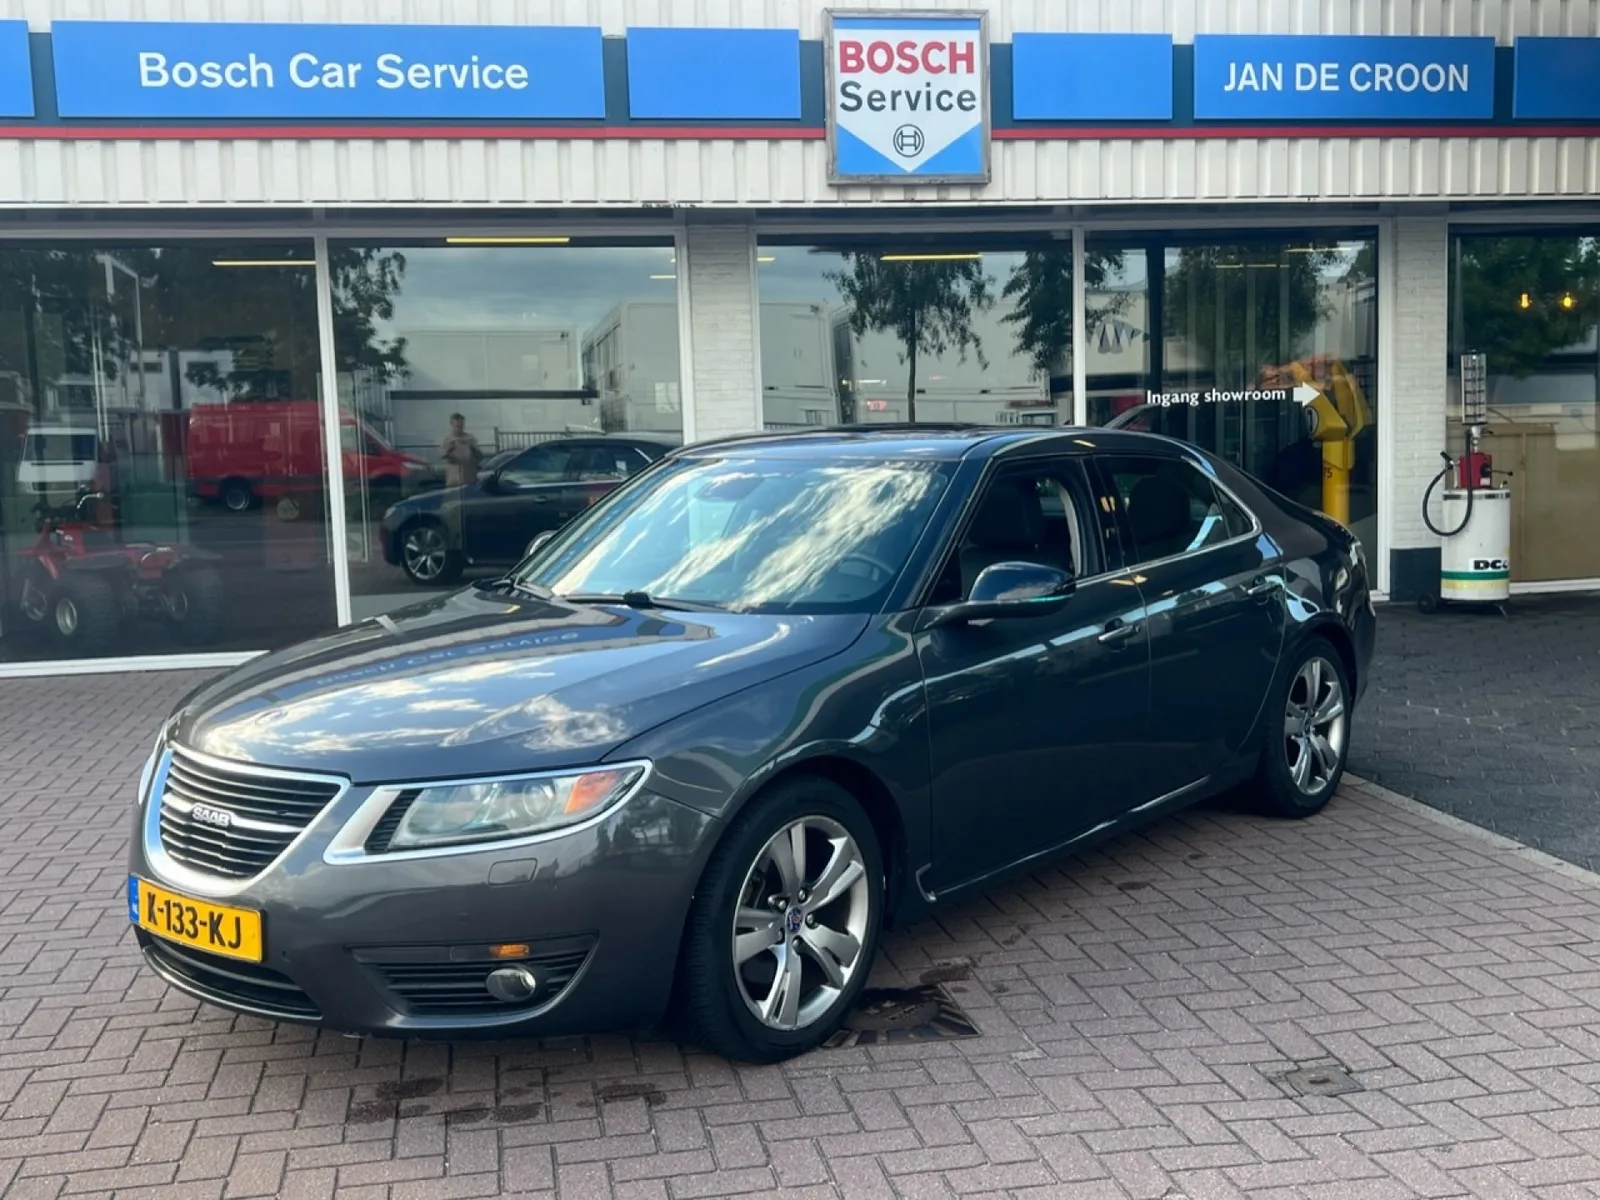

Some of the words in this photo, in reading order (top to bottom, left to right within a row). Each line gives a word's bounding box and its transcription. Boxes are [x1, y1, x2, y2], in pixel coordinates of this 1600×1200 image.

[139, 52, 274, 87] Bosch
[288, 52, 362, 88] Car
[376, 54, 529, 89] Service
[839, 40, 975, 74] BOSCH
[1224, 62, 1283, 91] JAN
[1295, 62, 1340, 91] DE
[1350, 62, 1469, 92] CROON
[839, 80, 977, 112] Service
[1147, 390, 1199, 407] Ingang
[1204, 388, 1286, 403] showroom
[192, 805, 231, 828] SAAB
[147, 891, 242, 950] K-133-KJ
